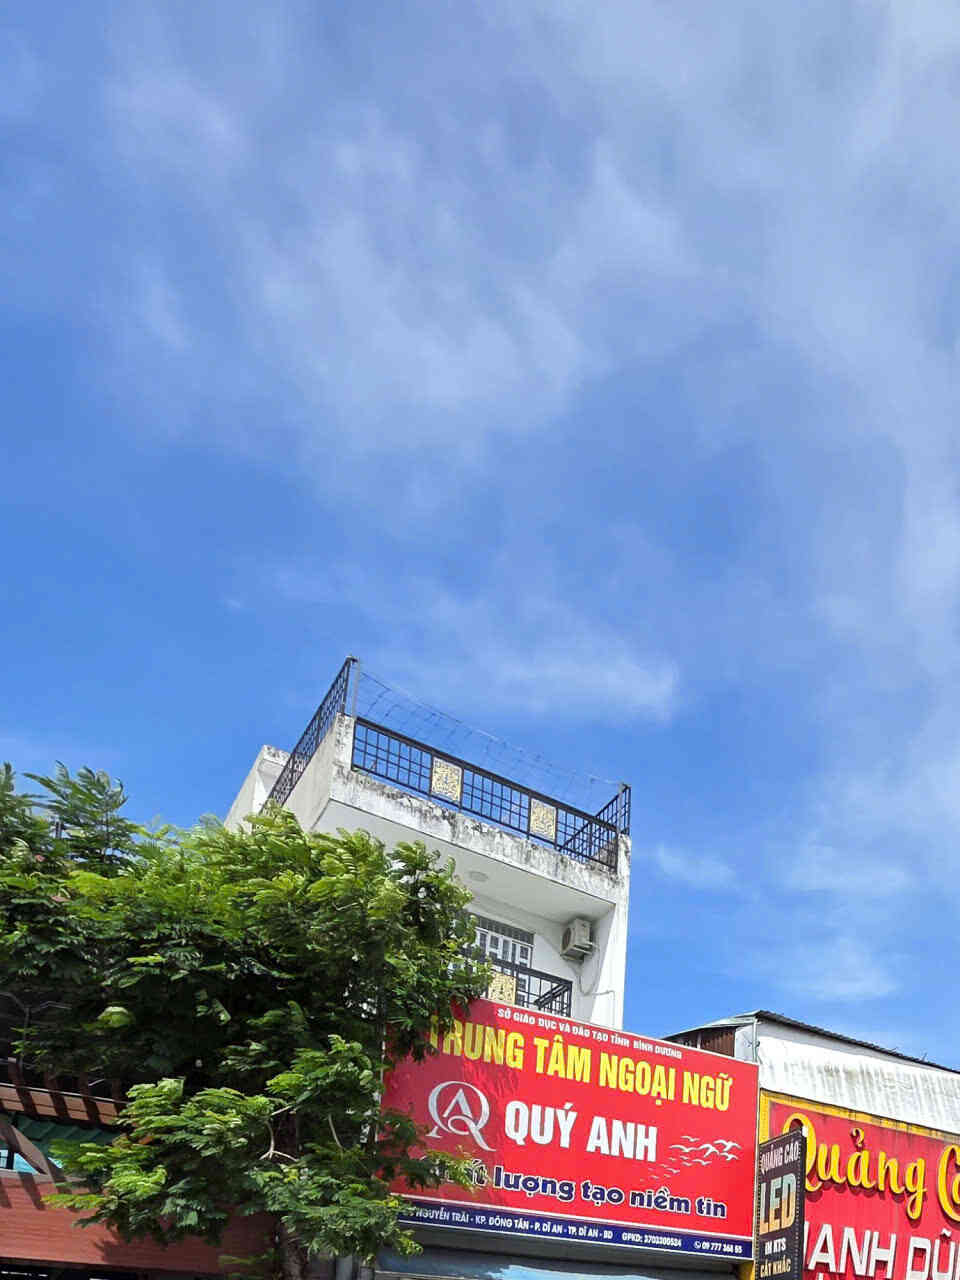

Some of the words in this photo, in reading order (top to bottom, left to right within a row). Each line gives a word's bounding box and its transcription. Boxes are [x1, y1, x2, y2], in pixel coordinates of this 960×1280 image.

[497, 1007, 512, 1019] SỞ
[513, 1011, 536, 1025] GIÁO
[537, 1015, 557, 1030] DỤC
[558, 1021, 571, 1033] VÀ
[591, 1029, 609, 1043] TẠO
[632, 1037, 653, 1053] BÌNH
[533, 1034, 592, 1085] TÂM
[598, 1053, 675, 1106] NGOẠI
[682, 1072, 734, 1112] NGỮ
[504, 1100, 578, 1149] QUÝ
[586, 1116, 658, 1163] ANH
[784, 1139, 799, 1162] CÁO
[493, 1165, 575, 1202] lượng
[581, 1181, 624, 1207] tạo
[630, 1186, 691, 1214] niềm
[696, 1197, 727, 1219] tin
[759, 1172, 797, 1236] LED
